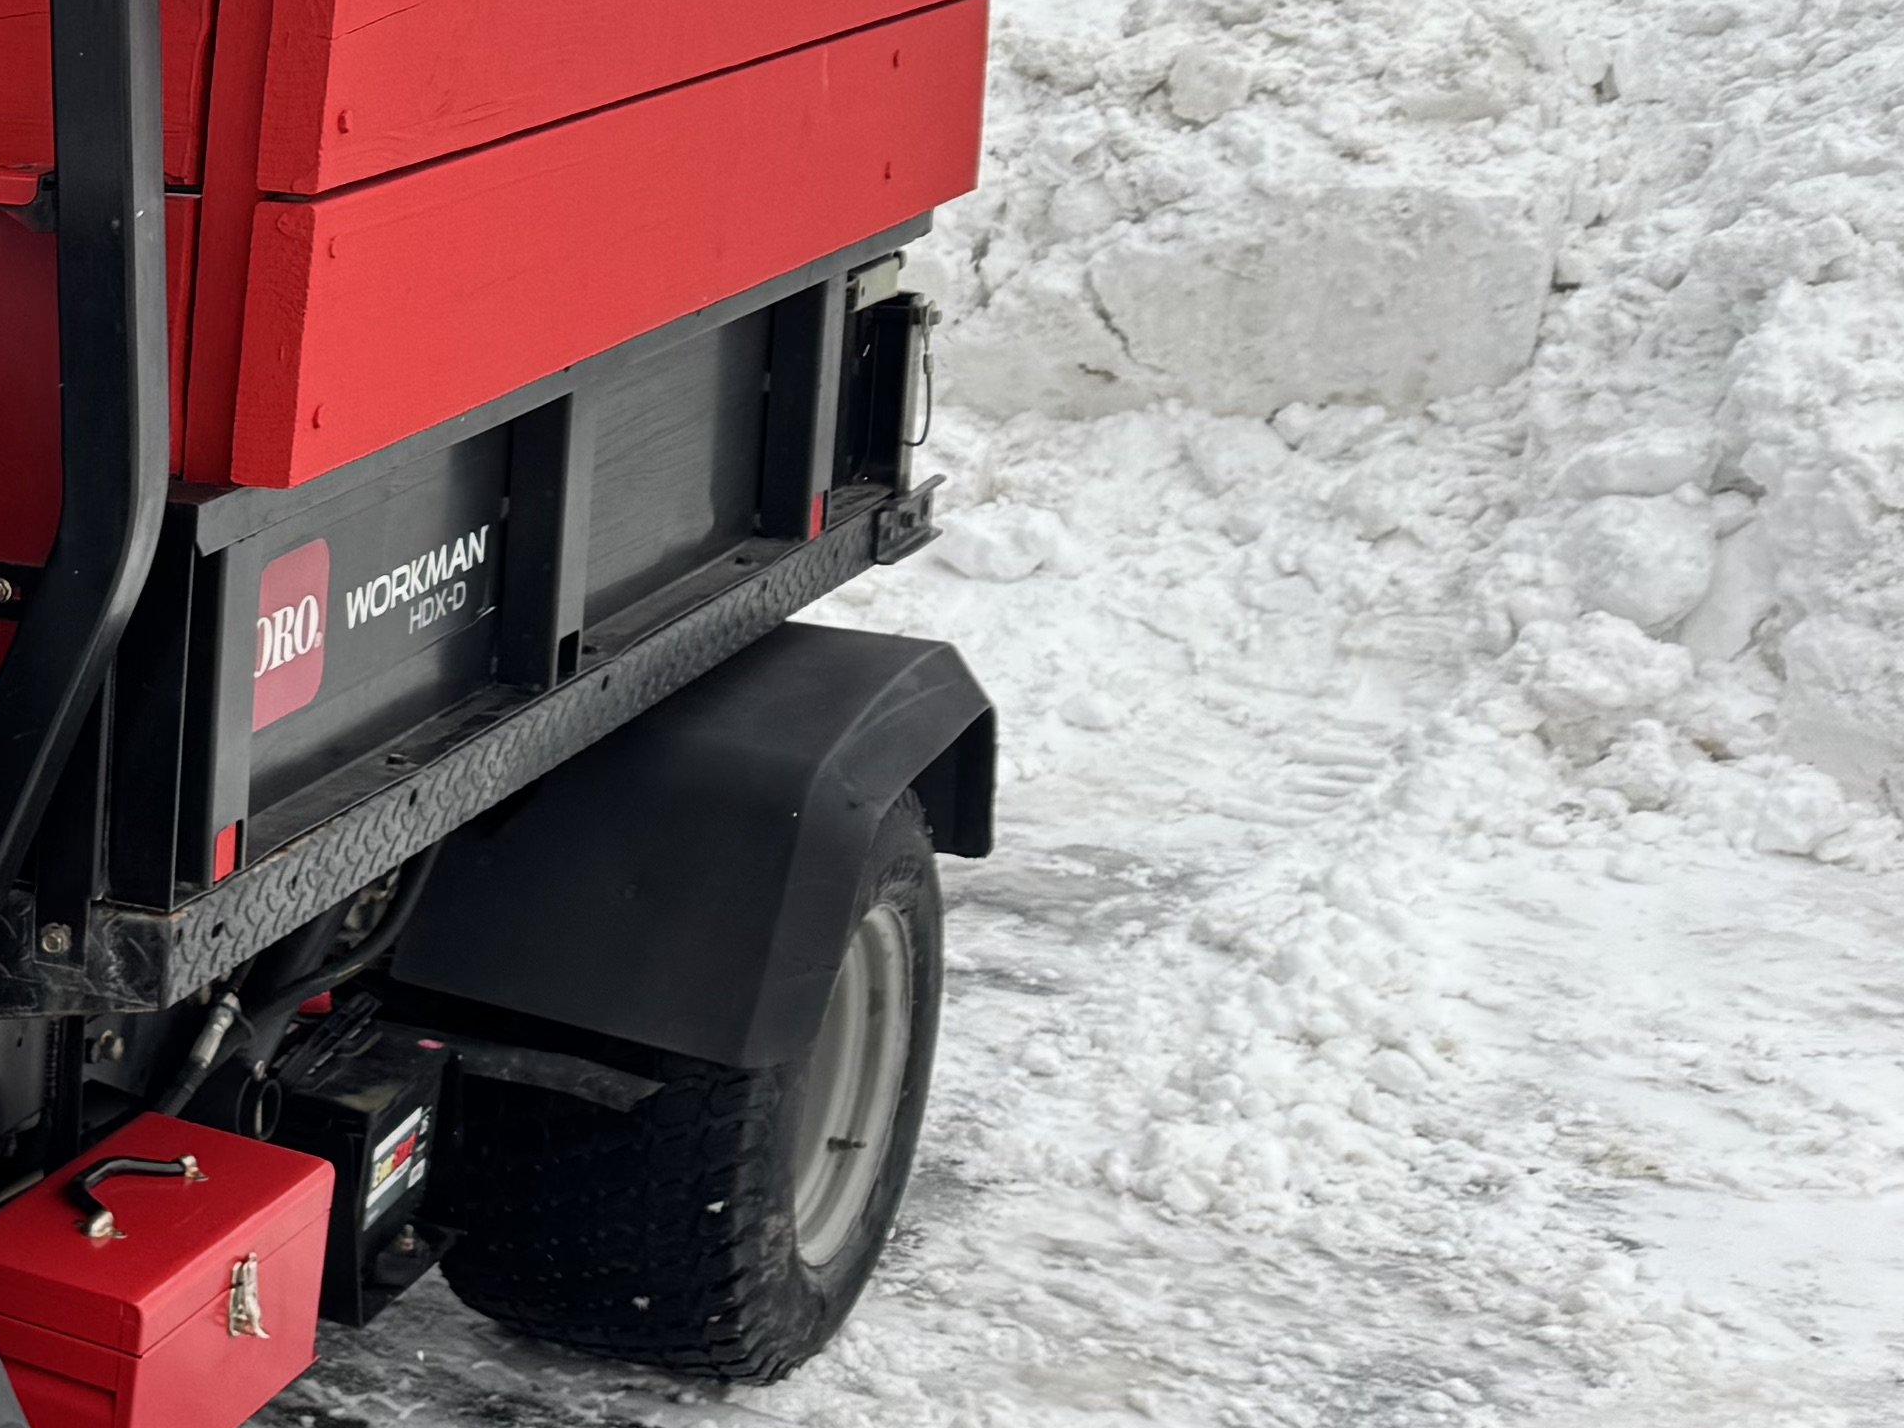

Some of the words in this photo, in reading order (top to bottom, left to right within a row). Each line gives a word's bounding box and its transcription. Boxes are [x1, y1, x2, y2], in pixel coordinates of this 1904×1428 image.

[347, 524, 489, 629] WORKMAN
[408, 581, 466, 635] HDX-D
[254, 595, 319, 678] ORO
